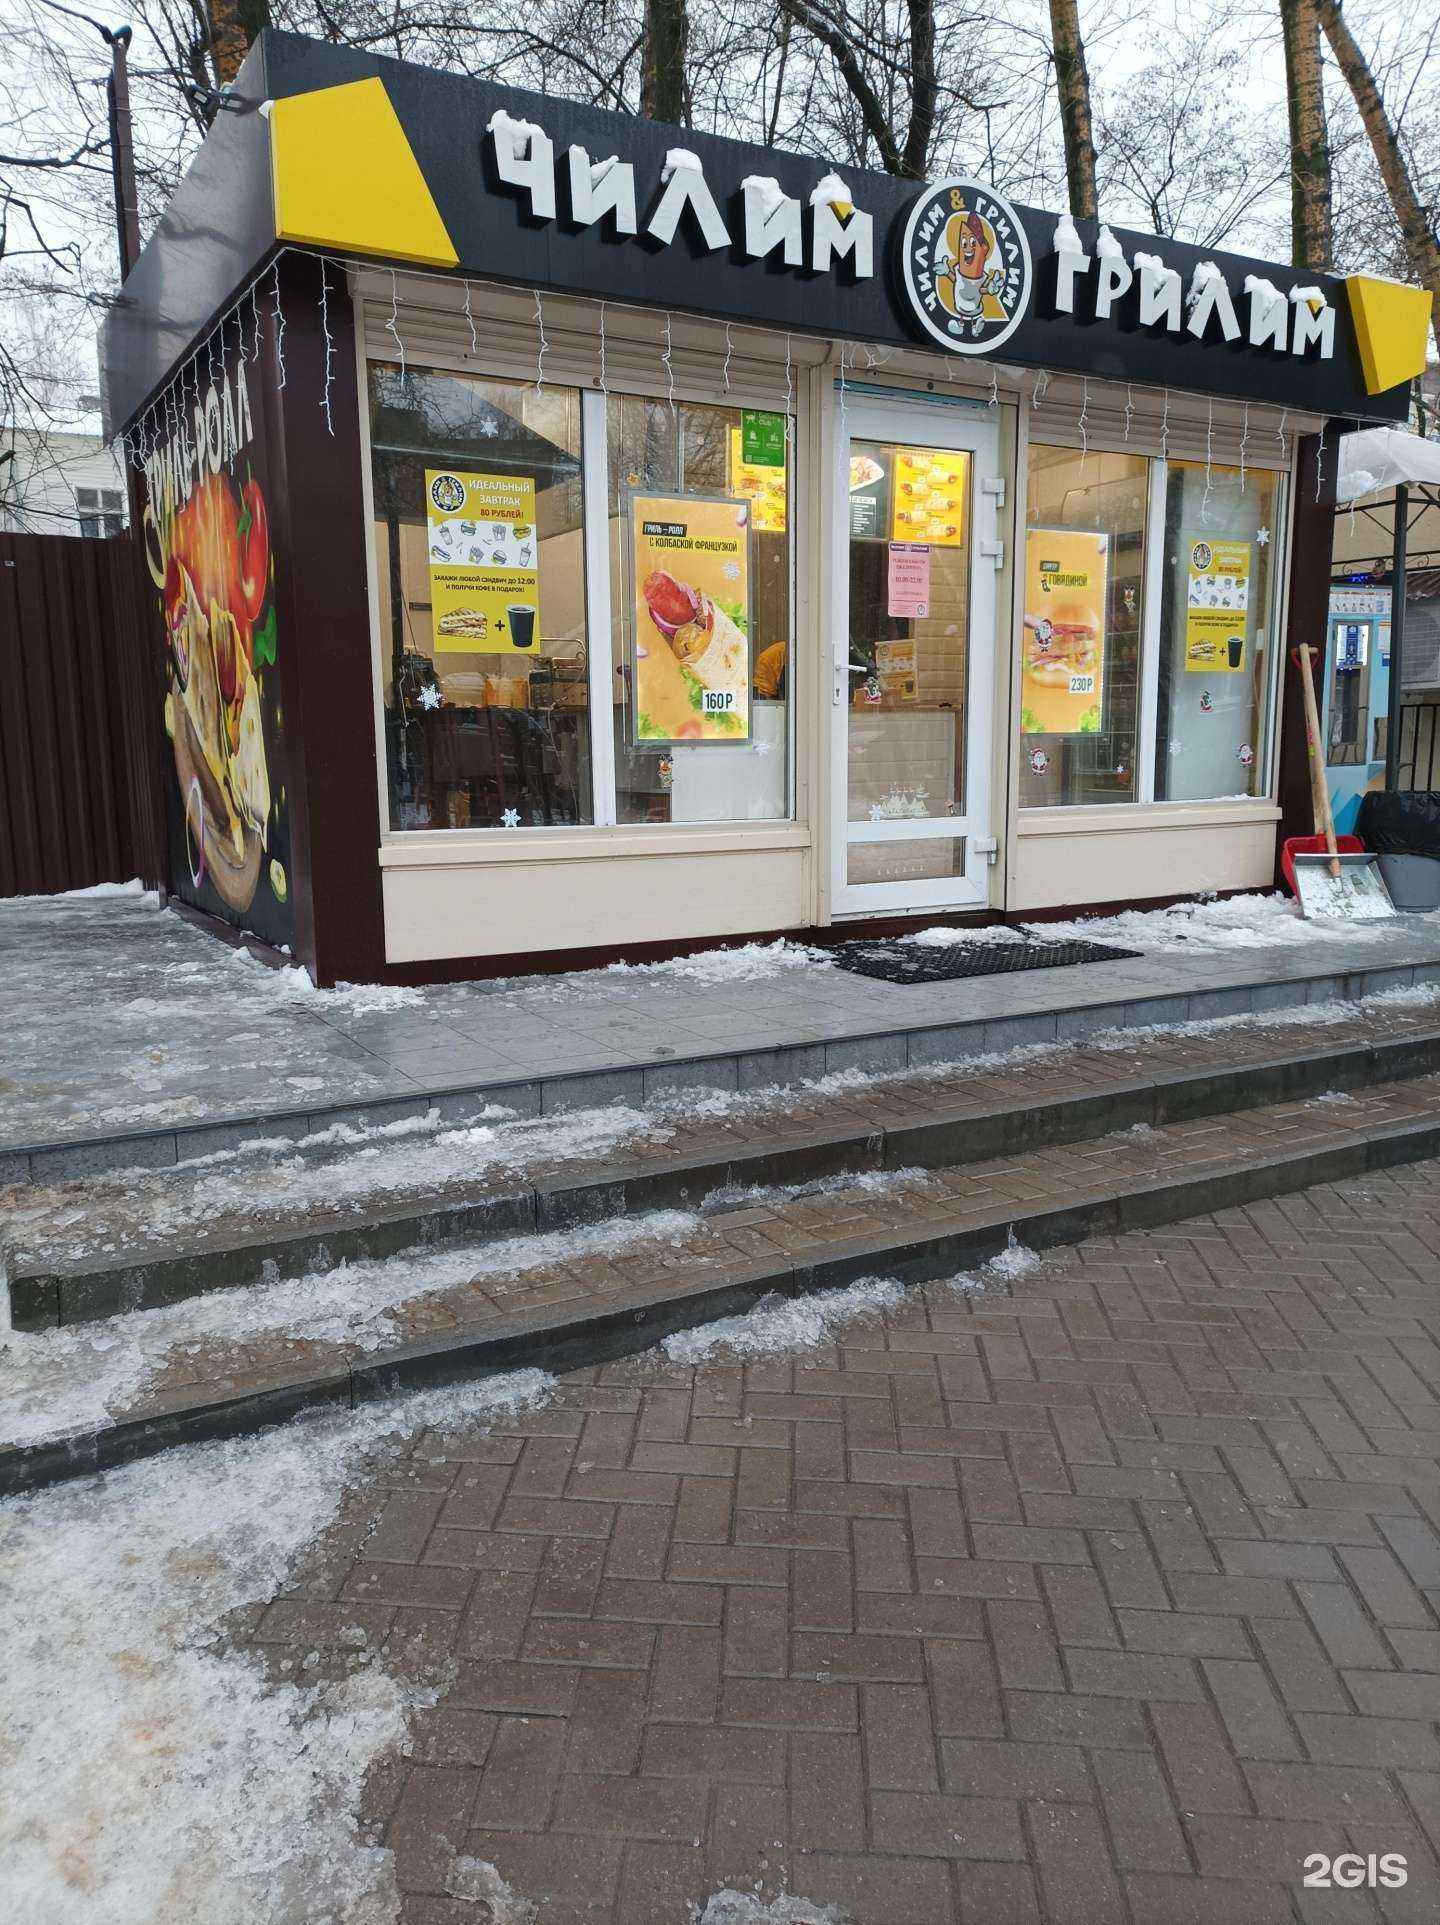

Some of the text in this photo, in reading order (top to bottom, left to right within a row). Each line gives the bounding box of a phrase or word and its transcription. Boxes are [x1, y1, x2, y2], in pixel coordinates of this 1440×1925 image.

[490, 116, 1336, 359] ЧИЛИМ ГРИЛИМ
[915, 188, 1021, 311] ЧИЛИМ & ГРИЛИМ
[469, 480, 530, 493] ИДЕАЛЬНЫЙ
[480, 494, 521, 506] ЗАВТРАК
[491, 508, 524, 519] РУБЛЕЙ!
[655, 537, 694, 550] КОЛБАСКОЙ
[694, 540, 738, 552] ФРАНЦУЗКОЙ
